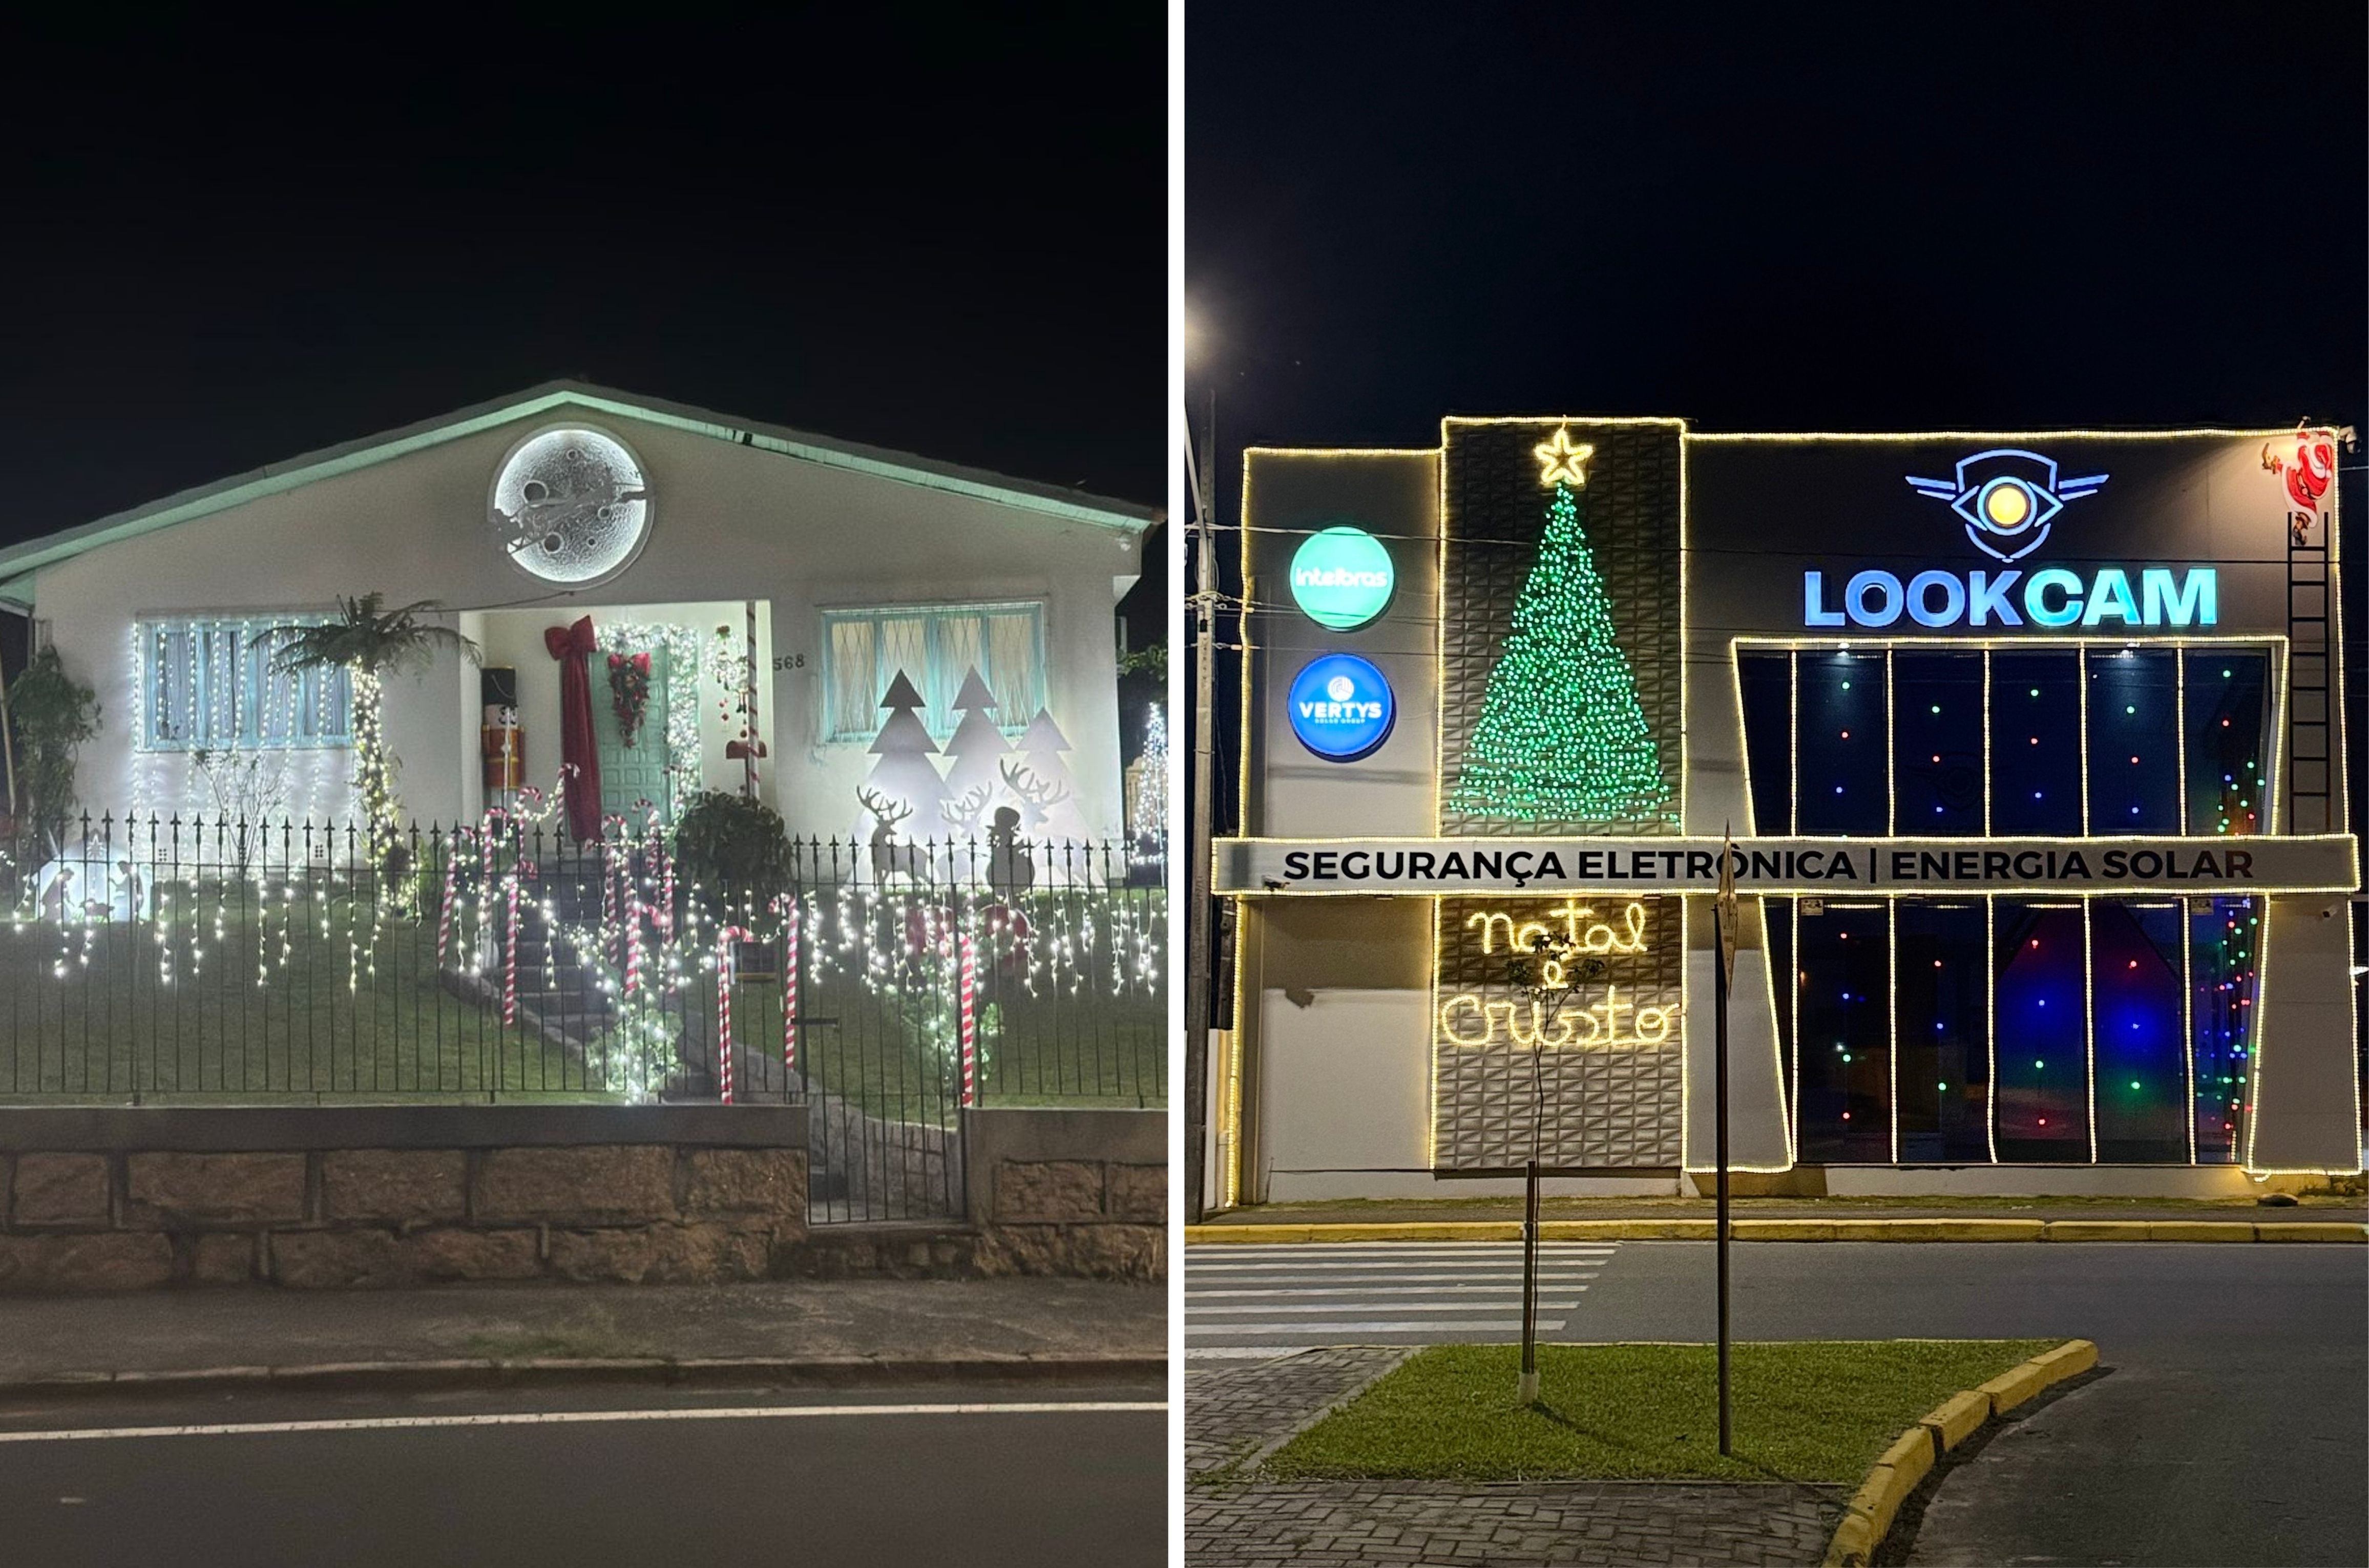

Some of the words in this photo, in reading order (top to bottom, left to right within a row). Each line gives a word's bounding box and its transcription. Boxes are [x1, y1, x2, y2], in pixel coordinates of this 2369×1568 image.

[1804, 568, 2218, 627] LOOKCAM
[772, 653, 805, 671] 568
[1299, 702, 1382, 718] VERTYS
[1284, 851, 1567, 887] SEGURANÇA
[1579, 843, 1857, 879] ELETRÔNICA
[1892, 851, 2092, 879] ENERGIA
[2102, 850, 2253, 879] SOLAR
